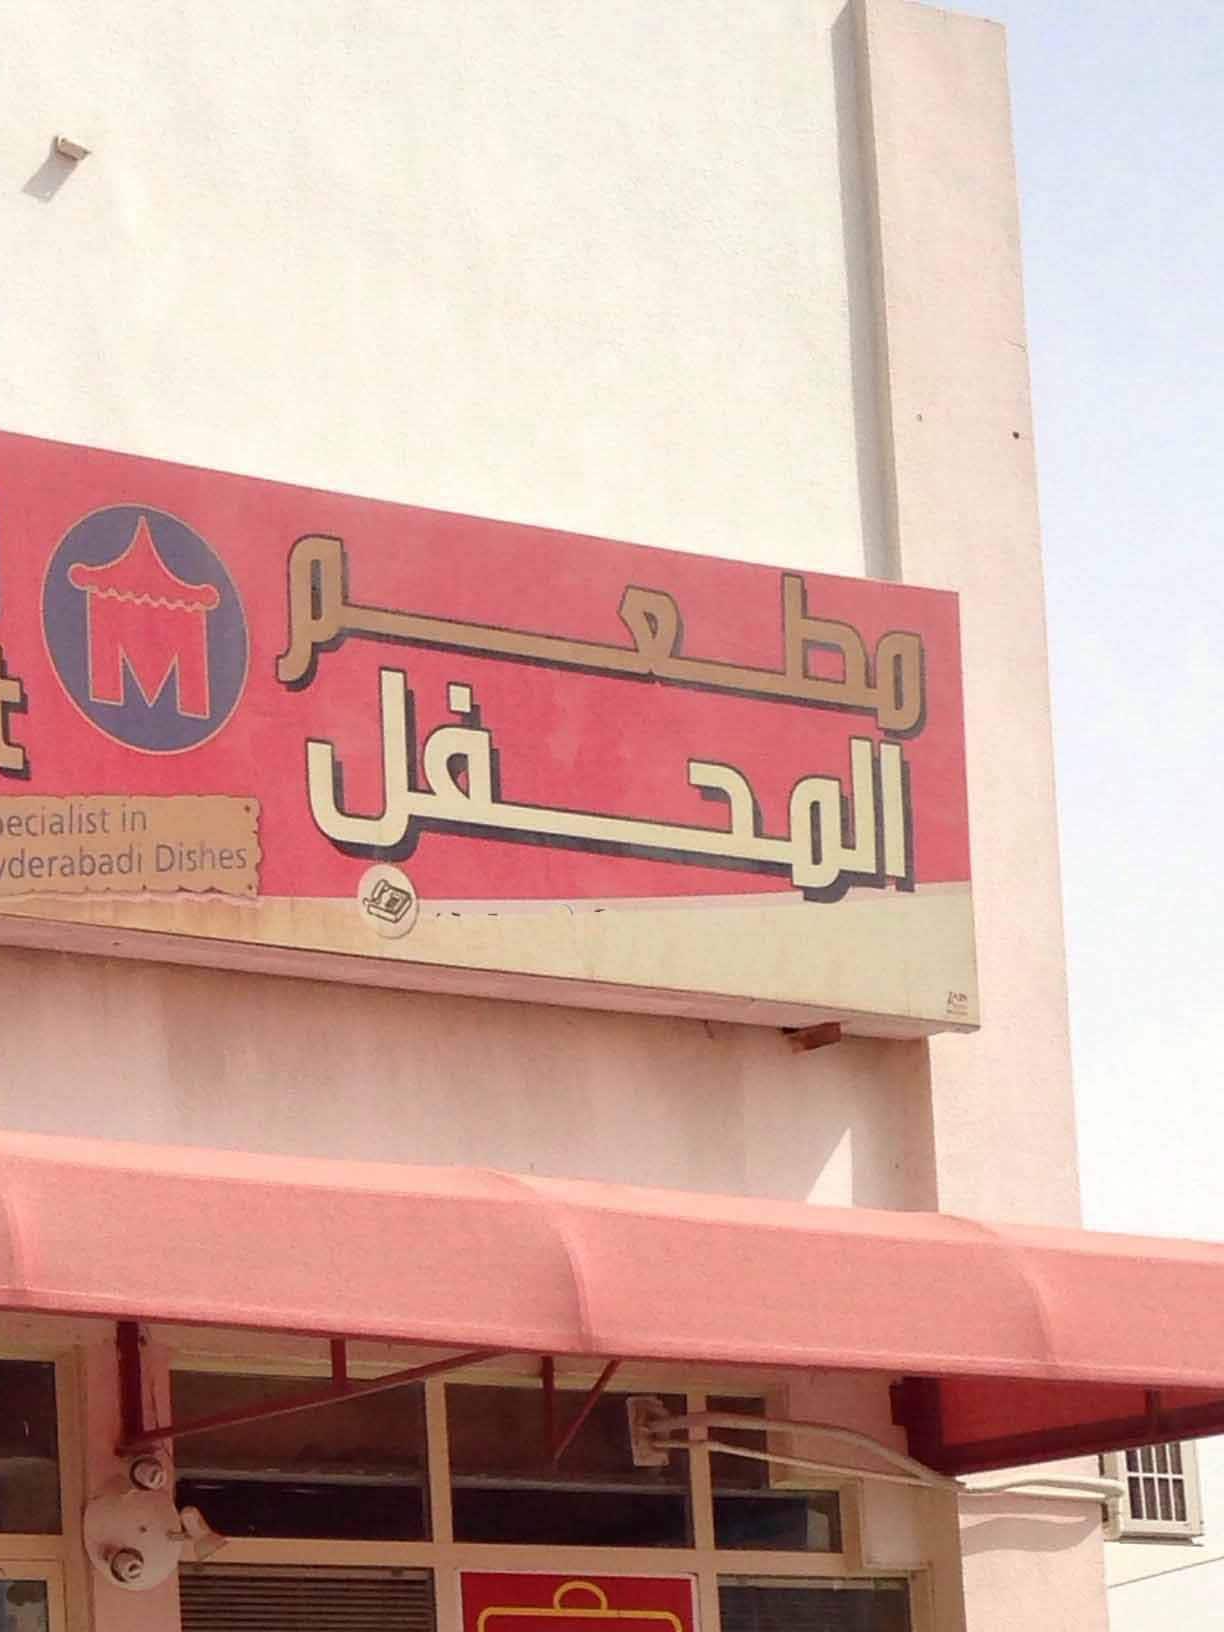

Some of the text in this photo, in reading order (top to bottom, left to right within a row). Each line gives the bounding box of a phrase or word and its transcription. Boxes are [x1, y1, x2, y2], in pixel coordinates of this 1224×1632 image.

[275, 532, 925, 738] مطعم
[121, 803, 147, 832] in
[305, 666, 914, 902] المحفل
[155, 840, 248, 873] Dishes
